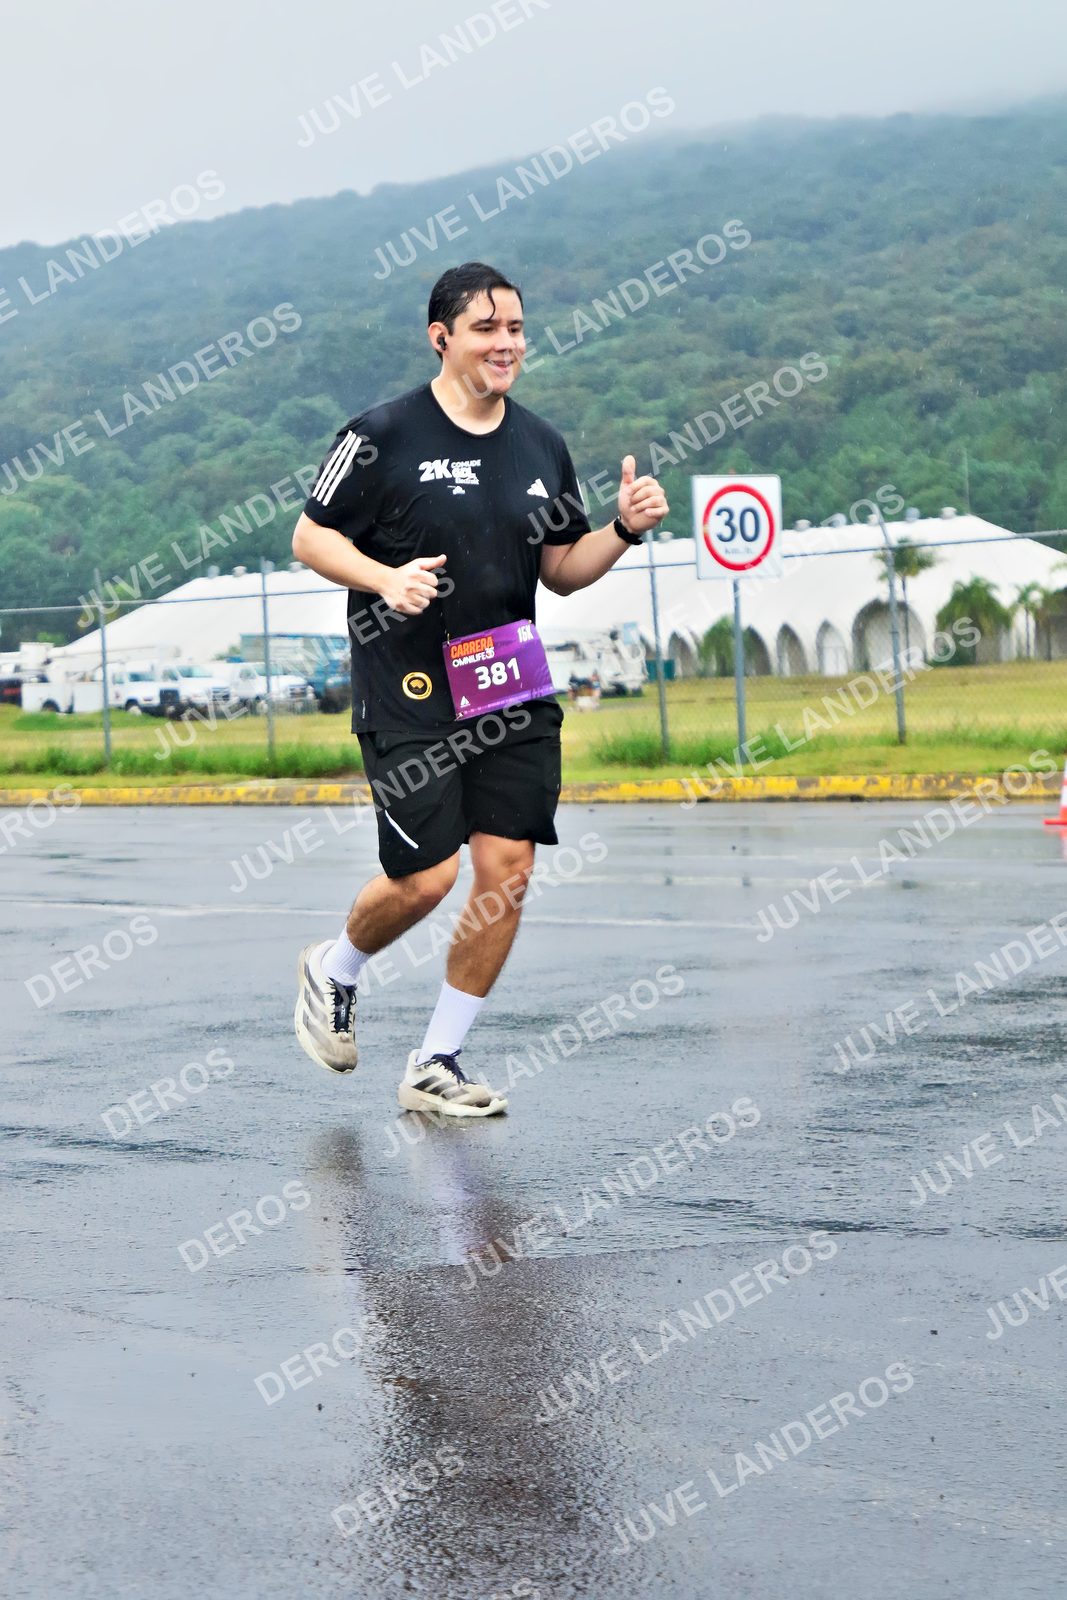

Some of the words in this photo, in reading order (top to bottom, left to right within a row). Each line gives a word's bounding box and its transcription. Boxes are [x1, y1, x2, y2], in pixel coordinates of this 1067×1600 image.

[715, 506, 760, 543] 30
[450, 635, 494, 659] CARRERA
[452, 652, 487, 668] OMNILIFE
[474, 657, 521, 690] 381
